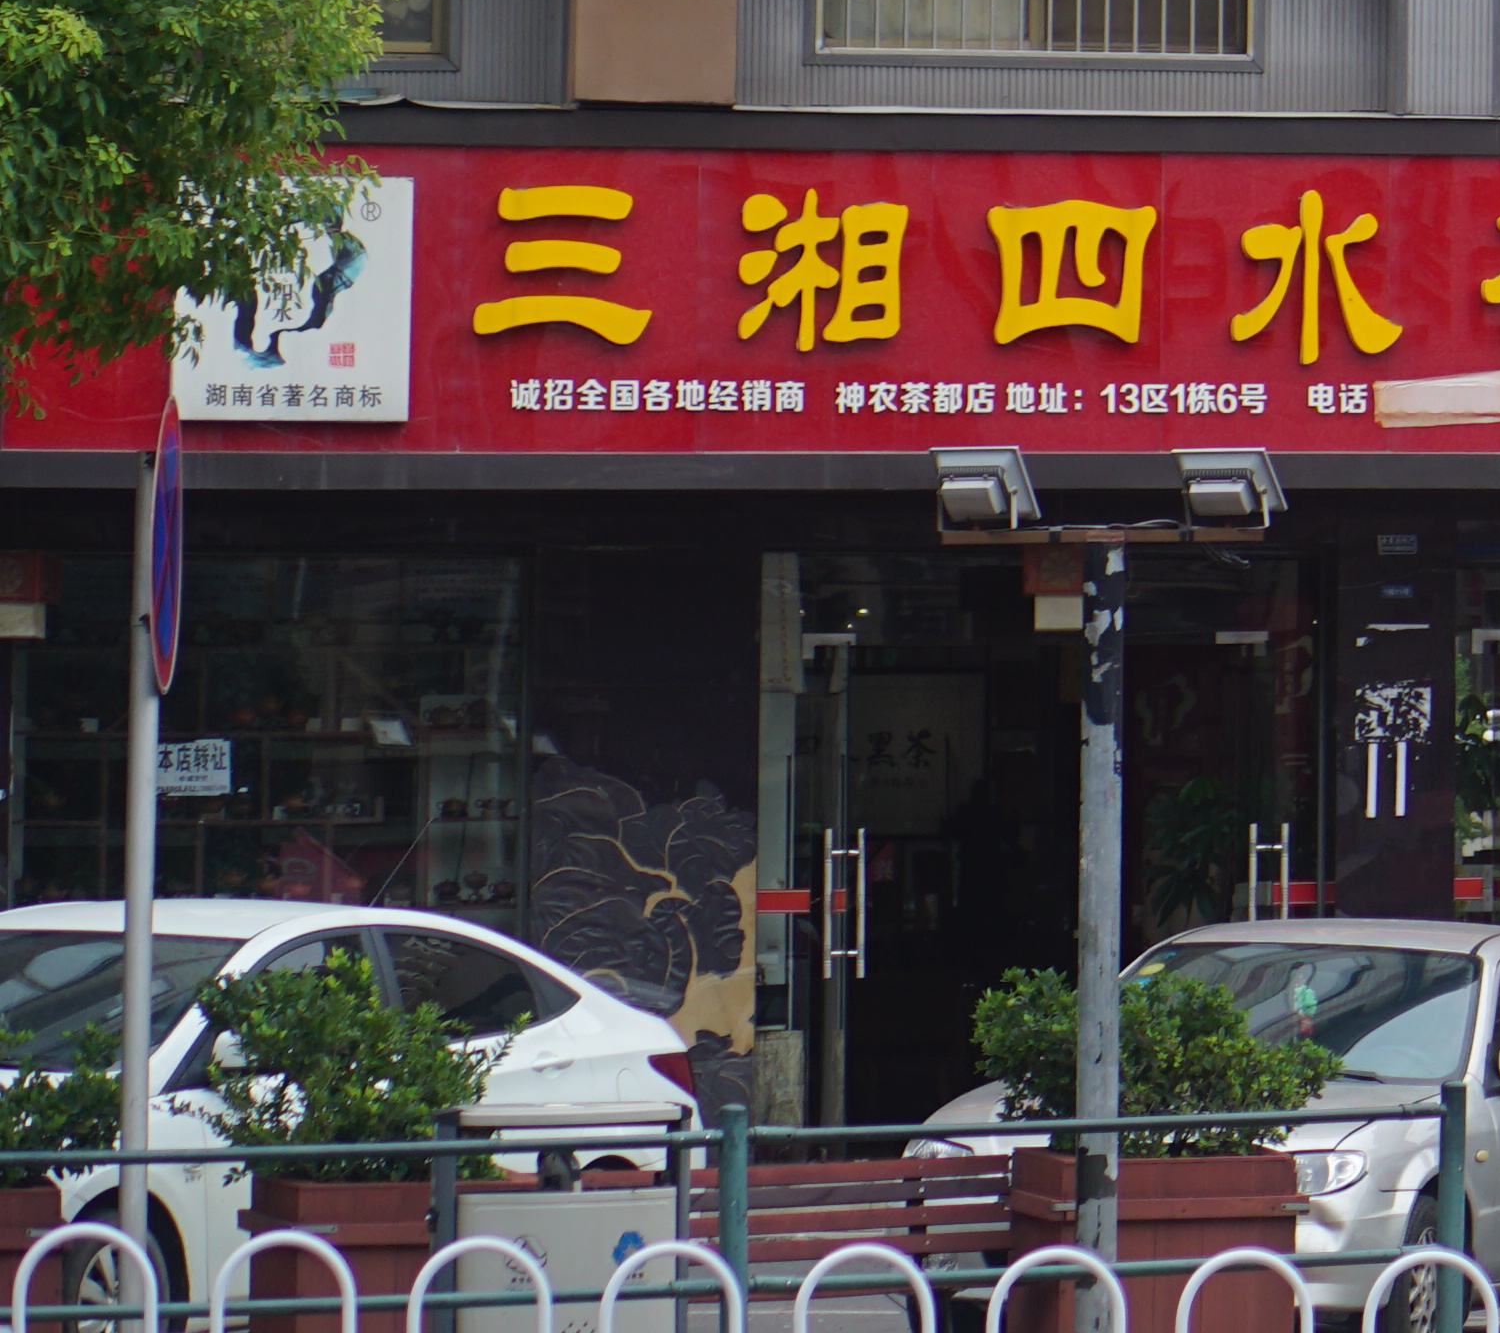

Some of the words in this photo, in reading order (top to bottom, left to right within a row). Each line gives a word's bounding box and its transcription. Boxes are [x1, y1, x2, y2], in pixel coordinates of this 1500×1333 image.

[205, 384, 382, 408] 湖南省著名商标
[510, 379, 805, 413] 诚招全国各地经销商
[835, 382, 995, 414] 神农茶都店
[1307, 383, 1368, 415] 电话
